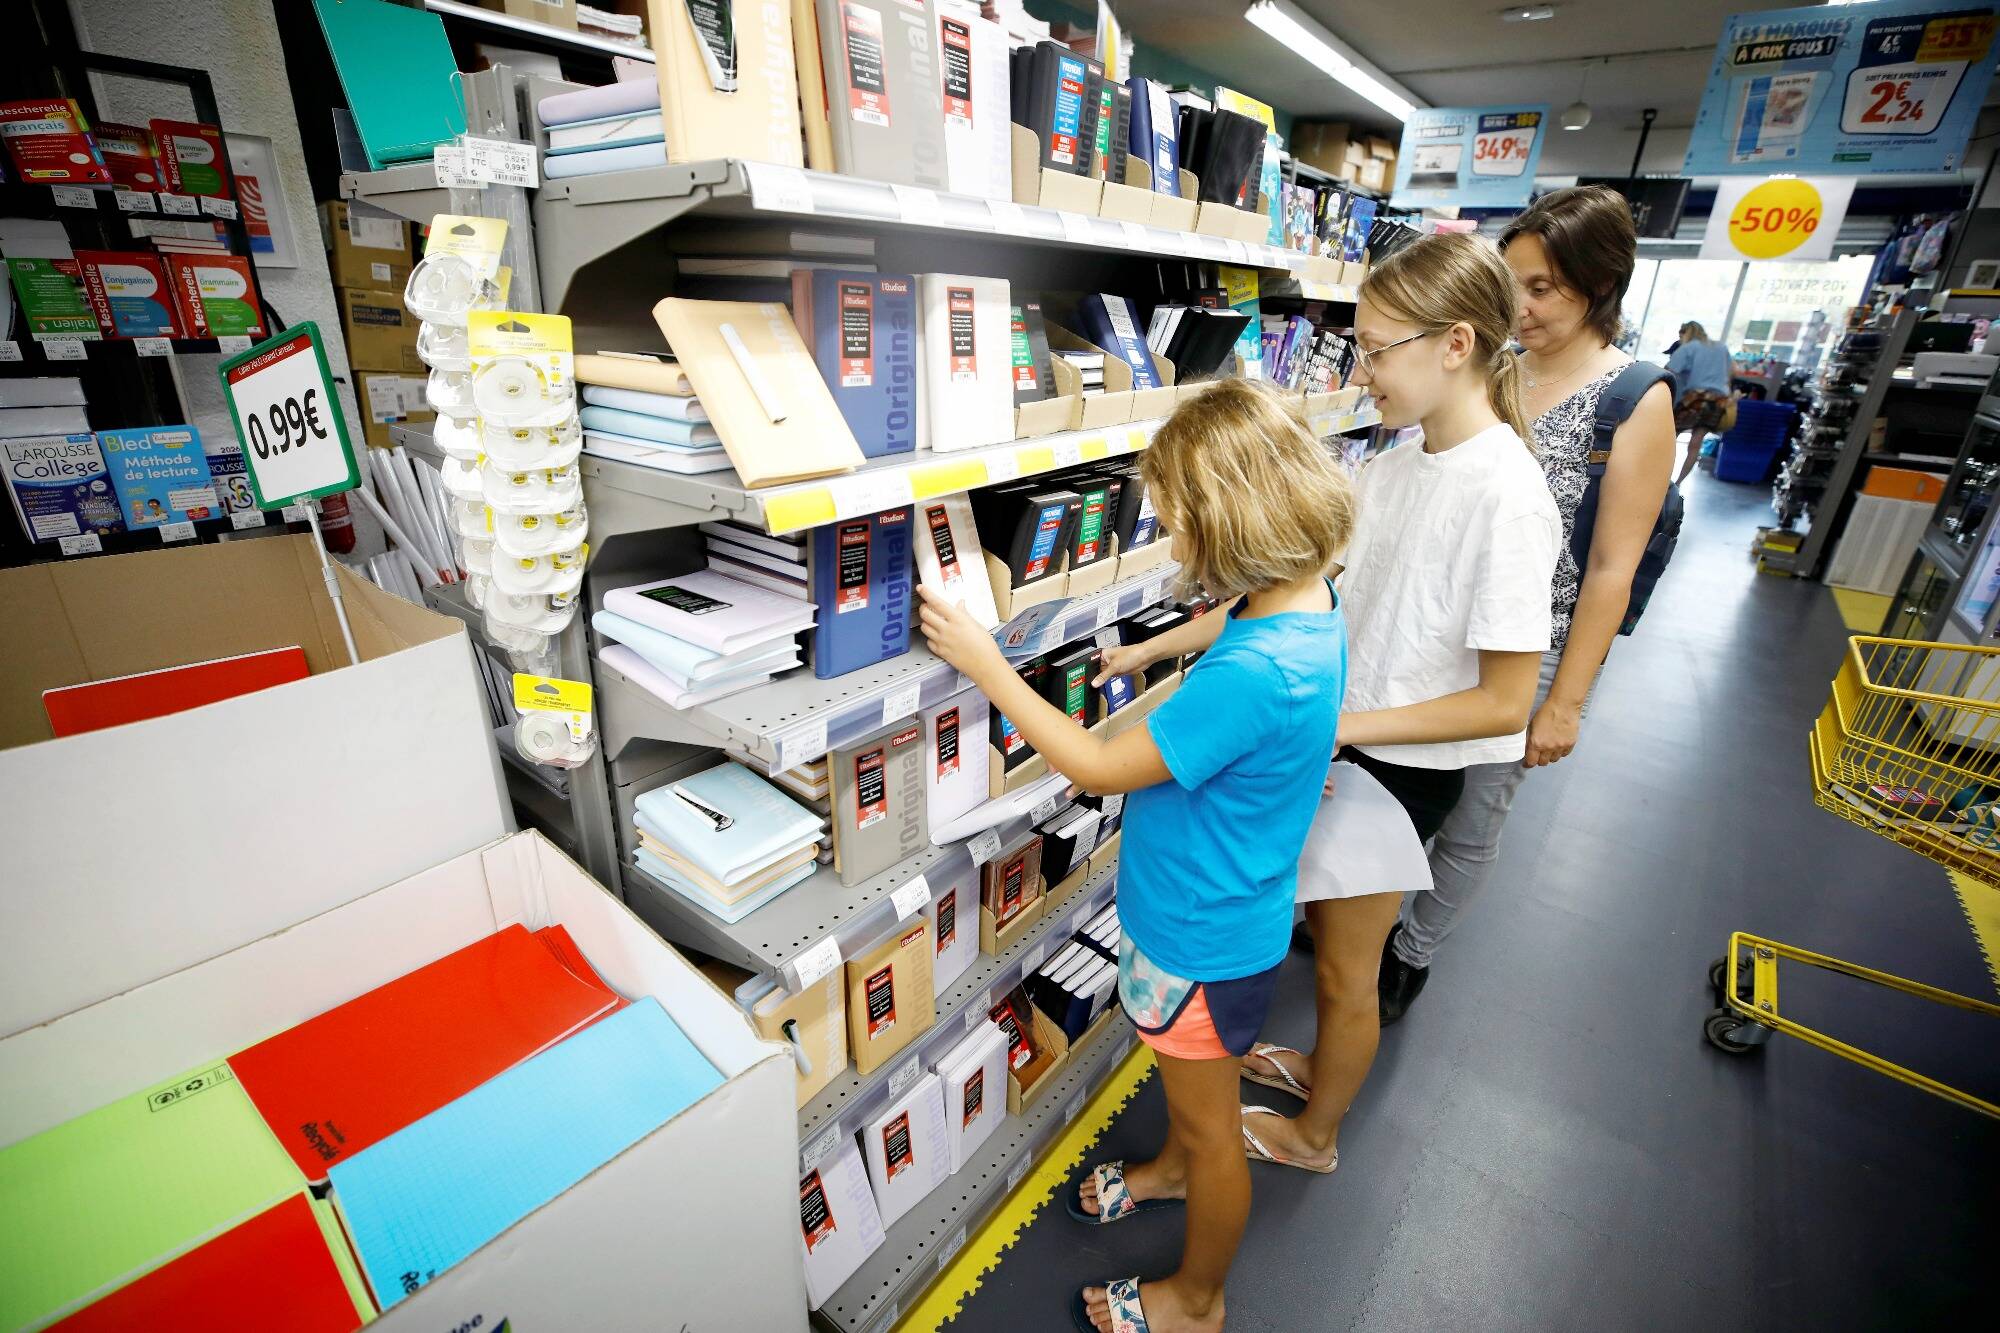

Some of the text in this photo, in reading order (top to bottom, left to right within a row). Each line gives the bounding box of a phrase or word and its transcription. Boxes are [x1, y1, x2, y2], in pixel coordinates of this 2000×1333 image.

[1765, 17, 1855, 39] MARQUES
[1736, 49, 1748, 62] À
[1751, 45, 1786, 59] PRIX
[1788, 40, 1823, 56] FOUS
[163, 134, 181, 185] Bescherelle
[471, 158, 487, 166] TTC
[1730, 207, 1818, 233] -50%
[104, 276, 154, 286] Conjugaison
[881, 281, 908, 293] l'Etudiant
[85, 263, 113, 327] Bescherelle
[182, 266, 203, 327] Bescherelle
[53, 319, 96, 330] Italien
[885, 301, 914, 450] l'Original
[248, 389, 328, 459] 0.99€
[4, 443, 96, 462] LAROUSSE
[104, 434, 152, 453] Bled
[13, 458, 100, 479] Collège
[124, 453, 193, 469] Méthode
[210, 461, 246, 474] ROUSSE
[124, 465, 199, 481] de lecture
[879, 512, 906, 525] l'Etudiant
[881, 527, 909, 659] l'Original
[892, 730, 918, 746] l'Etudiant
[860, 758, 880, 771] l'Etudiant
[899, 747, 923, 857] l'Original
[901, 930, 924, 947] l'Etudiant
[869, 976, 889, 991] l'Etudiant
[301, 1121, 339, 1161] Recyclé
